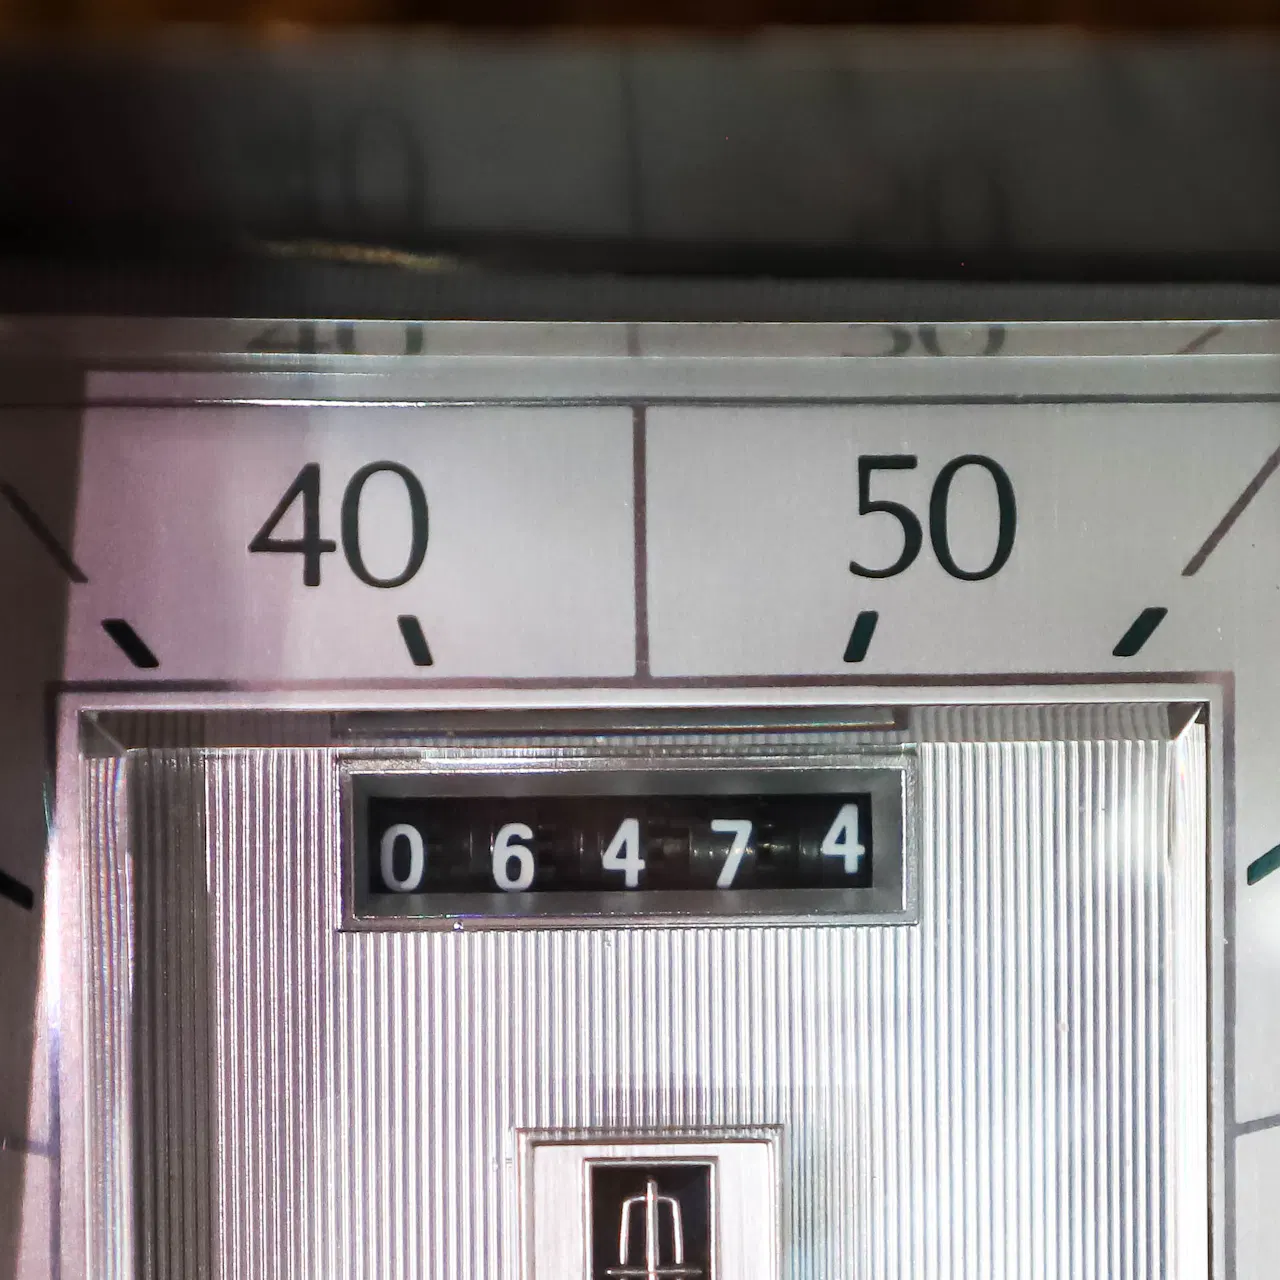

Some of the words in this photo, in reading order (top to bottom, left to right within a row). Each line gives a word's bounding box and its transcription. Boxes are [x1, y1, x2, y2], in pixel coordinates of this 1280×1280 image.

[248, 459, 429, 589] 40
[848, 453, 1018, 581] 50
[380, 803, 866, 893] 06474
